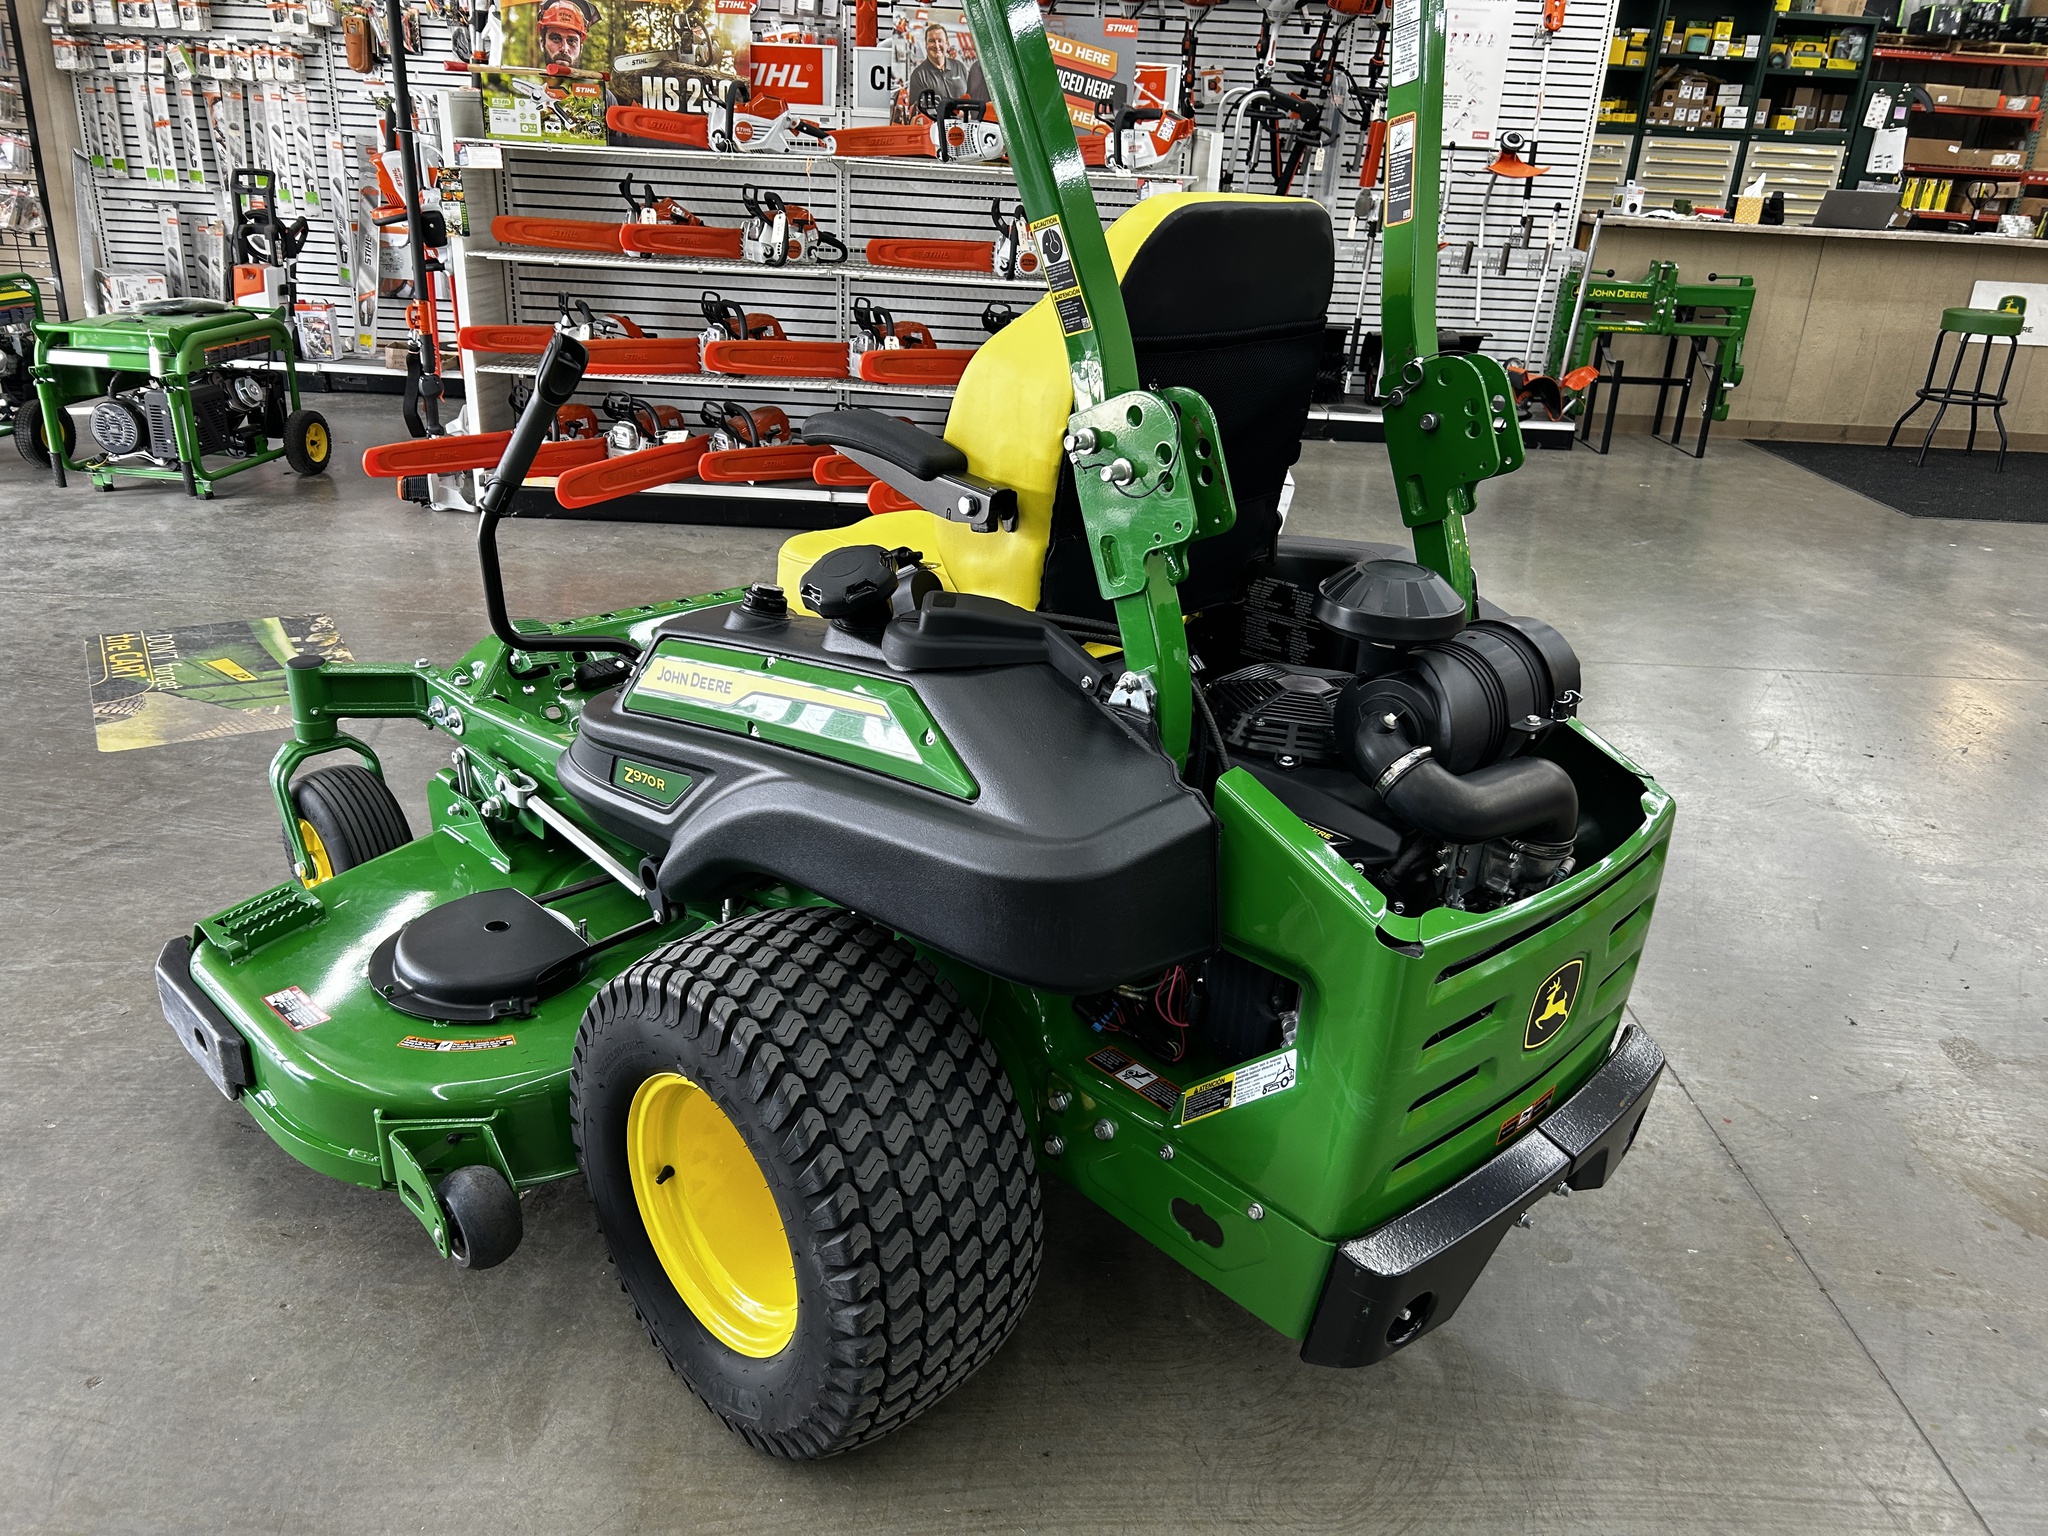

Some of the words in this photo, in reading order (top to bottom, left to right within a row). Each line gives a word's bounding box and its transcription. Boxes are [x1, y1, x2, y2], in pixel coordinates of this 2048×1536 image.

[717, 0, 746, 9] STIHL
[1106, 23, 1135, 33] STIHL
[1048, 38, 1073, 54] OLD
[1075, 46, 1111, 66] HERE
[632, 58, 648, 66] STIHL
[750, 63, 809, 88] TIHL
[1057, 69, 1084, 93] ICED
[641, 76, 679, 112] MS
[1073, 110, 1106, 126] HER
[650, 120, 677, 131] STIHL
[868, 137, 894, 146] STIHL
[1037, 217, 1057, 229] CAUTION
[552, 229, 579, 238] STIHL
[676, 236, 701, 245] STIHL
[365, 236, 373, 266] STIHL
[923, 250, 948, 259] STIHL
[1589, 289, 1616, 298] JOHN
[1617, 290, 1649, 299] DEERE
[501, 335, 528, 343] STIHL
[623, 352, 648, 360] STIHL
[771, 354, 796, 363] STIHL
[763, 459, 786, 468] STIHL
[106, 634, 140, 651] the
[146, 634, 178, 660] DON'T
[108, 651, 147, 679] CART
[147, 662, 183, 691] forget
[657, 666, 689, 686] JOHN
[690, 672, 733, 694] DEERE
[624, 766, 665, 791] Z970R
[1200, 1077, 1225, 1092] ATENCIÓN
